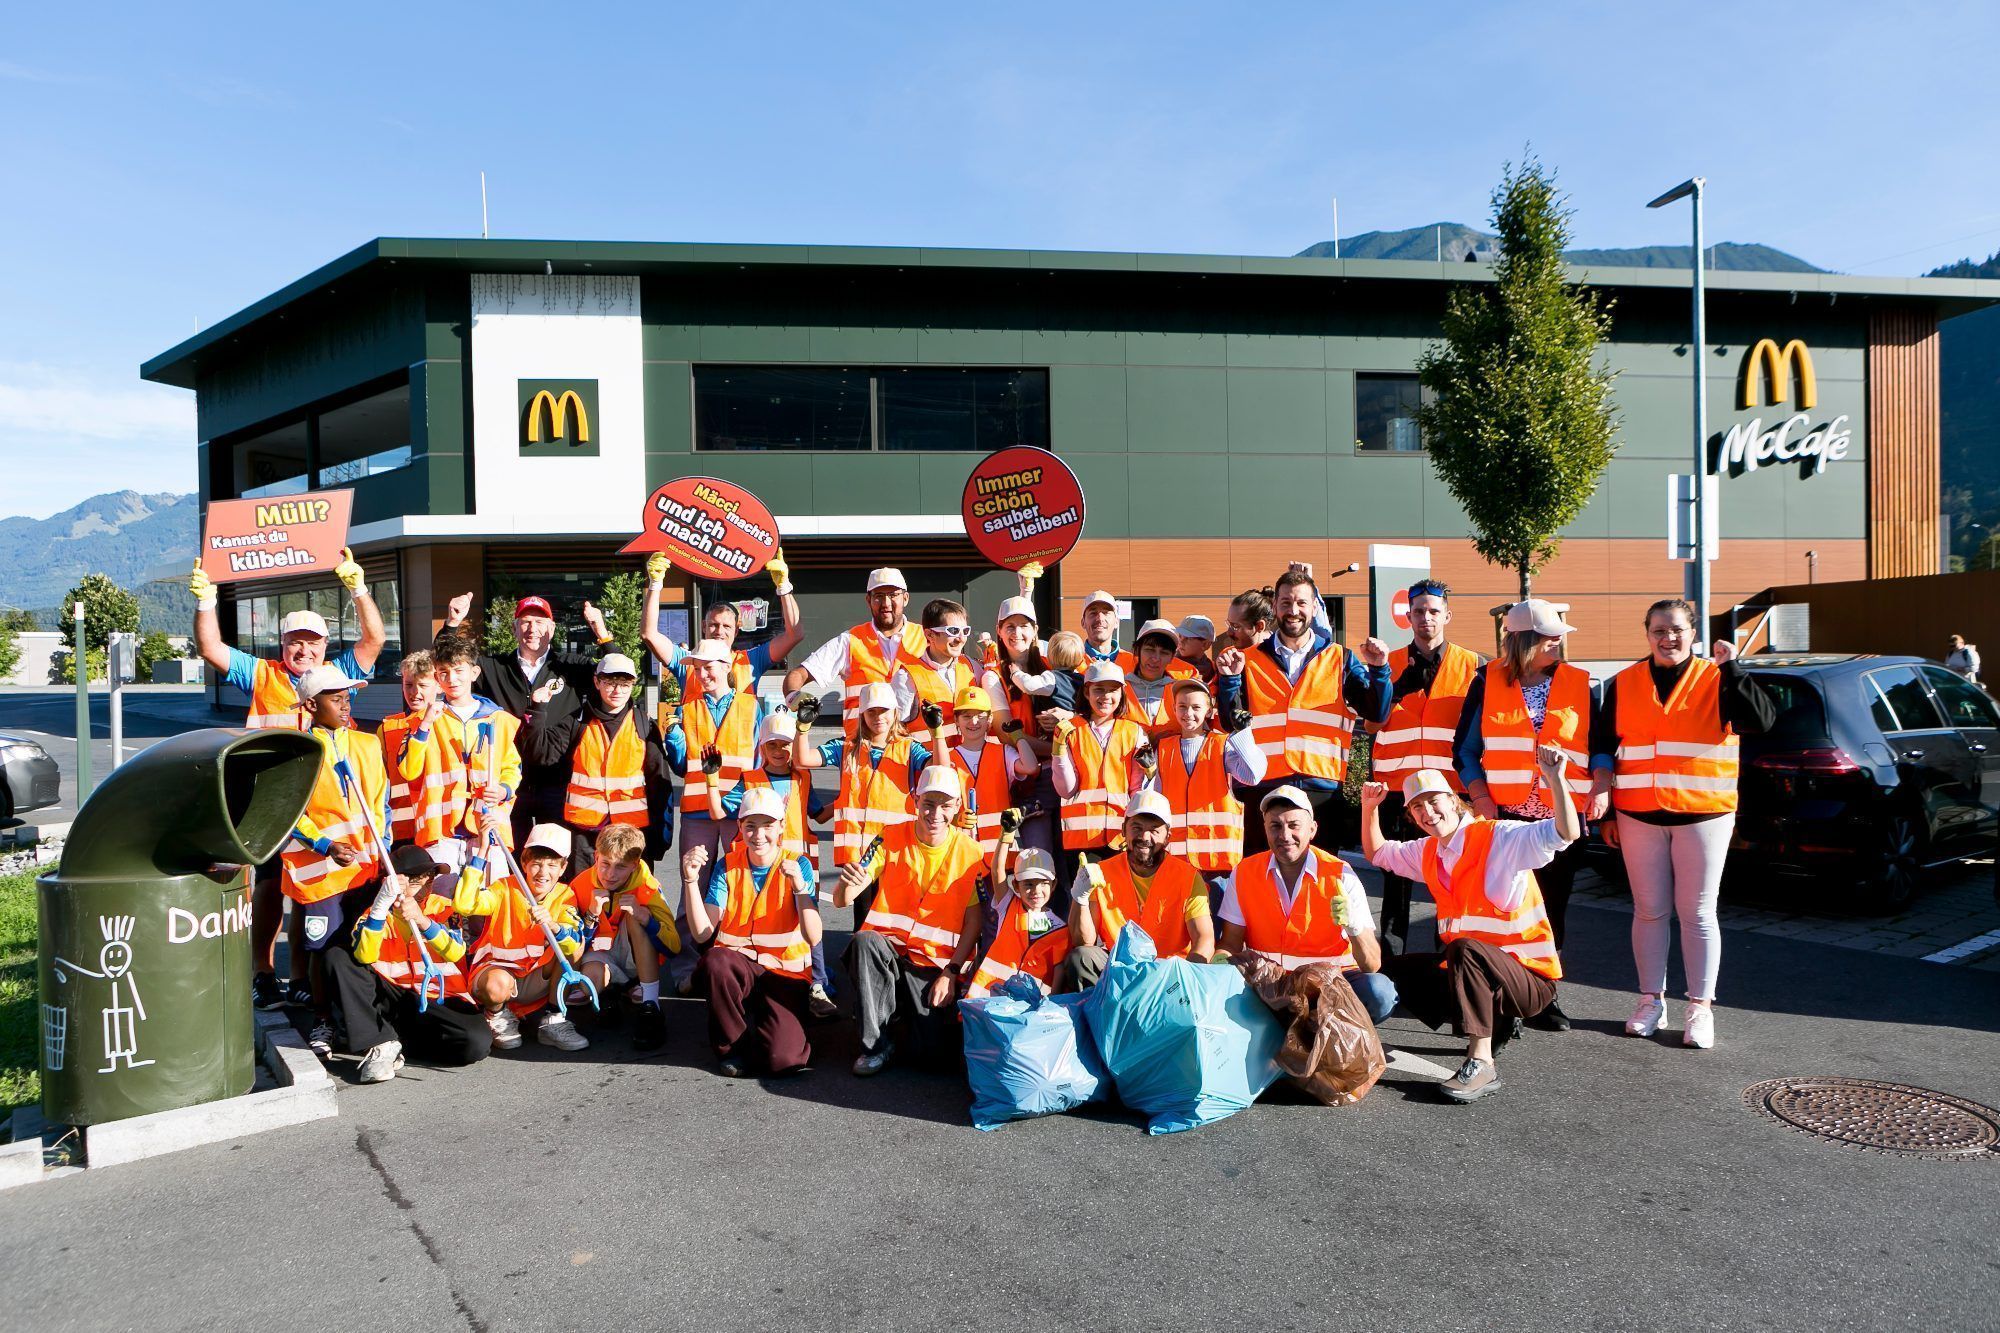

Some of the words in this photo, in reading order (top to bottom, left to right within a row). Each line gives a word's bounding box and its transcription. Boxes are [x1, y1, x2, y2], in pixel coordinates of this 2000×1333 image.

[1717, 413, 1851, 474] McCafé
[977, 467, 1042, 494] Immer
[693, 483, 740, 512] Mäcci
[972, 489, 1035, 517] schön
[256, 500, 331, 527] Müll?
[656, 495, 697, 525] und
[695, 510, 728, 542] ich
[983, 504, 1040, 533] sauber
[1010, 506, 1078, 541] bleiben!
[210, 532, 267, 549] Kannst
[268, 529, 288, 543] du
[725, 510, 774, 547] macht's
[229, 547, 316, 572] kübeln.
[659, 516, 712, 553] mach
[712, 542, 755, 574] mit!
[667, 543, 691, 559] Mission
[690, 555, 723, 575] Aufräumen
[1004, 553, 1029, 564] Mission
[1029, 546, 1063, 558] Aufräumen
